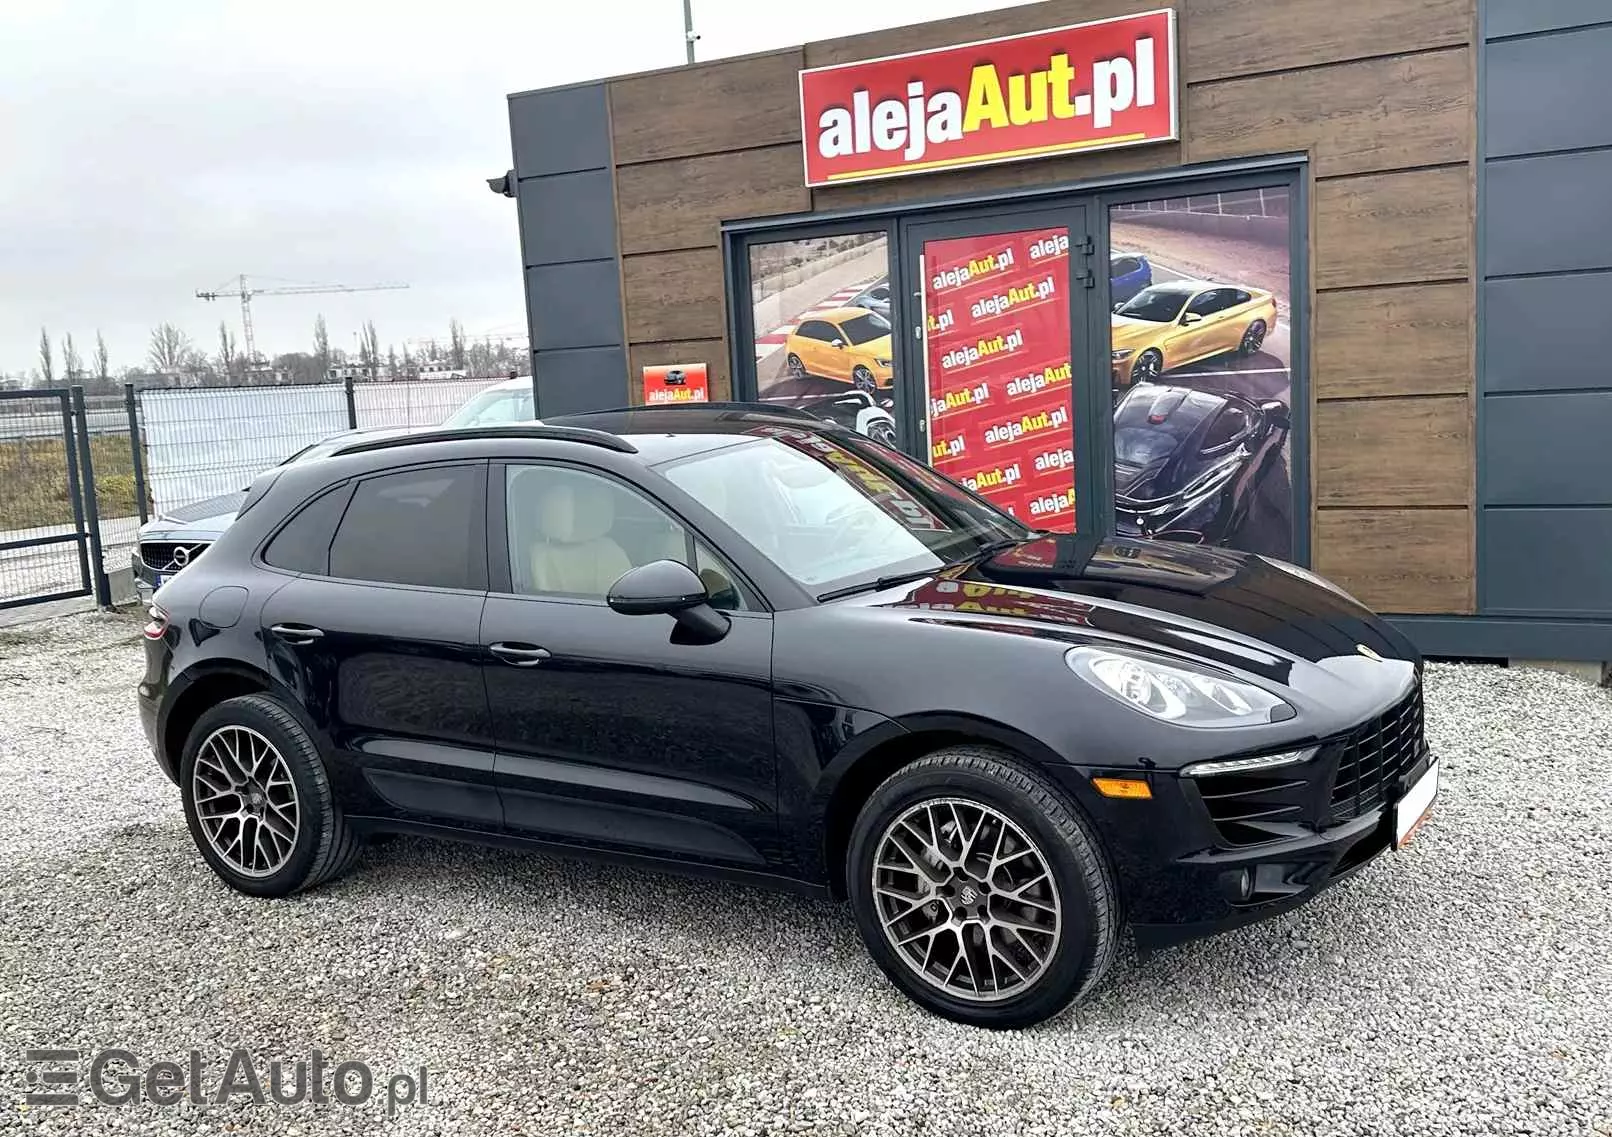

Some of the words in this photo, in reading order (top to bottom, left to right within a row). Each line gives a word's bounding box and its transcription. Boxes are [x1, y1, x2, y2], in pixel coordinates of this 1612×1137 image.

[818, 37, 1155, 161] alejaAut.pl
[933, 248, 1014, 289] alejaAut.pl
[971, 277, 1055, 318] alejaAut.pl
[942, 329, 1023, 368] alejaAut.pl
[649, 387, 704, 401] alejaAut.pl
[985, 406, 1068, 443] alejaAut.pl
[1035, 448, 1074, 470] aleja
